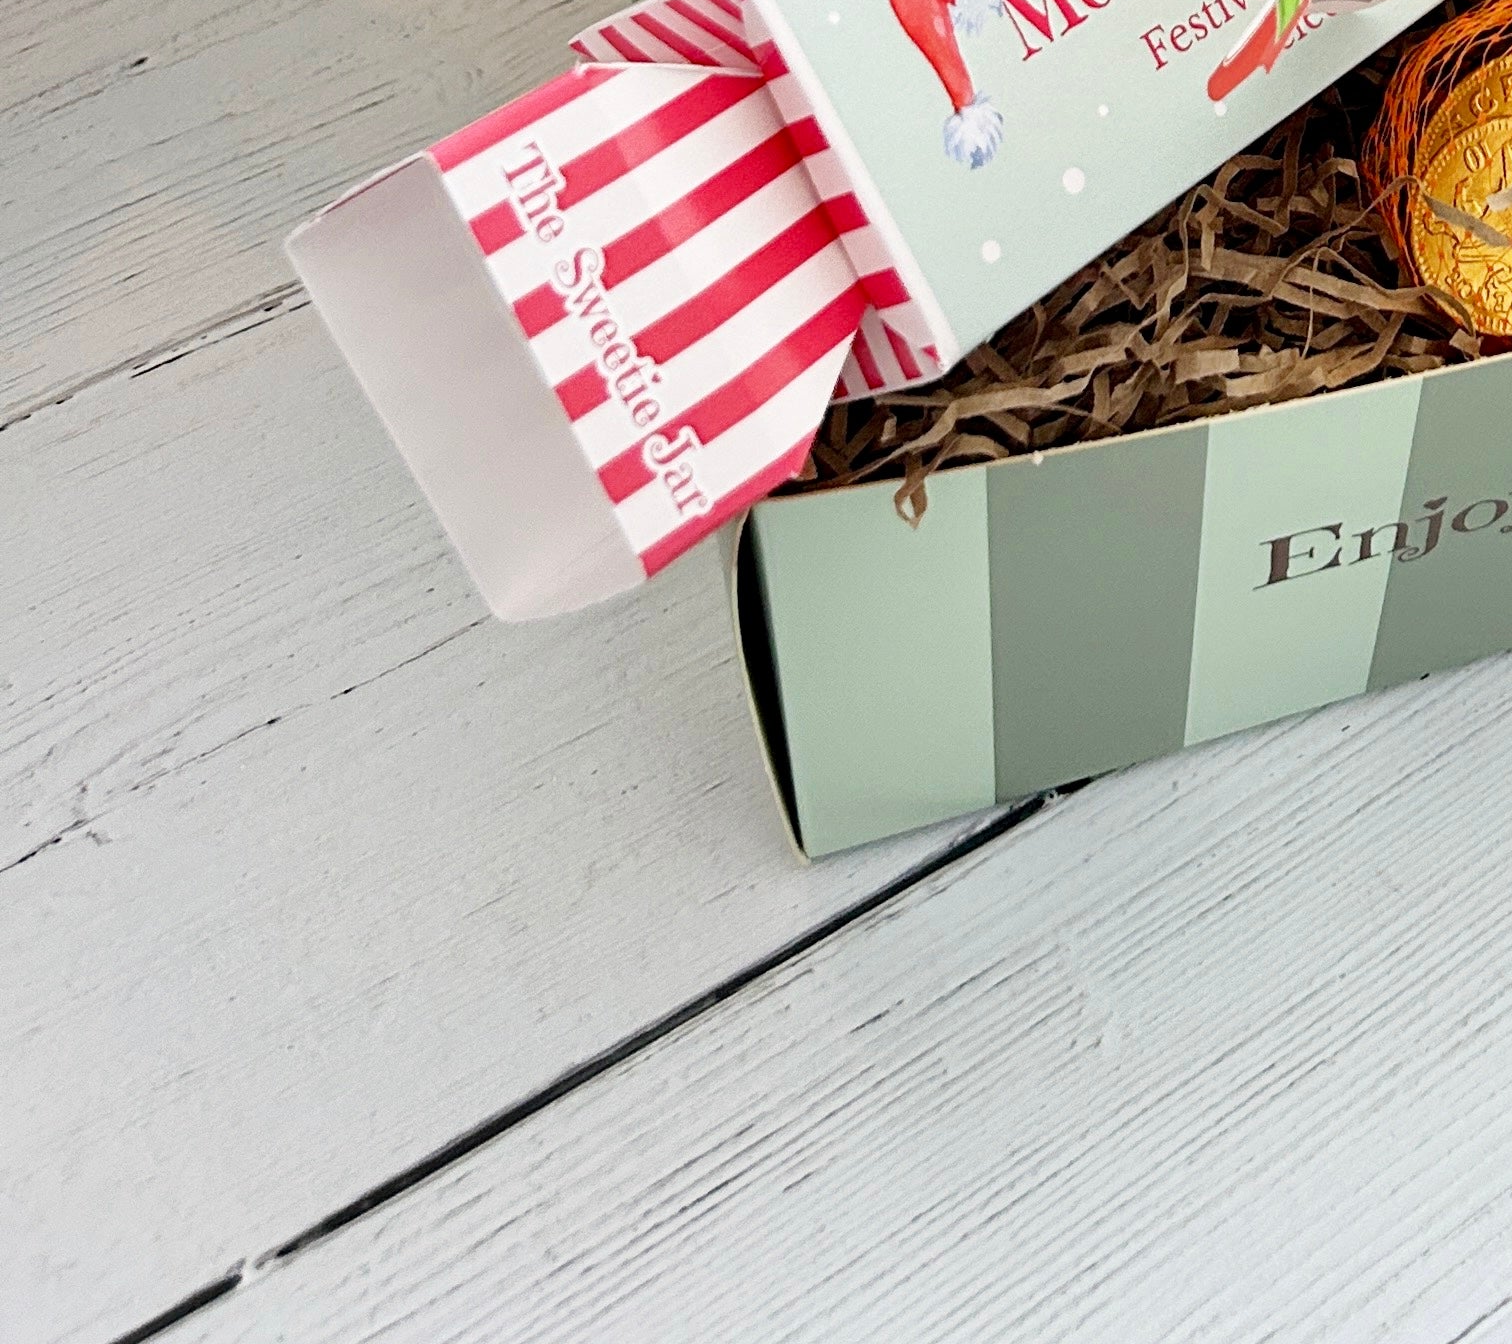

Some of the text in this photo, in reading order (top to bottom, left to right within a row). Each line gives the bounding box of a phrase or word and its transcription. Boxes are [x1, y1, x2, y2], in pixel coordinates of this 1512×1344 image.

[502, 141, 708, 515] The Sweetie Jar
